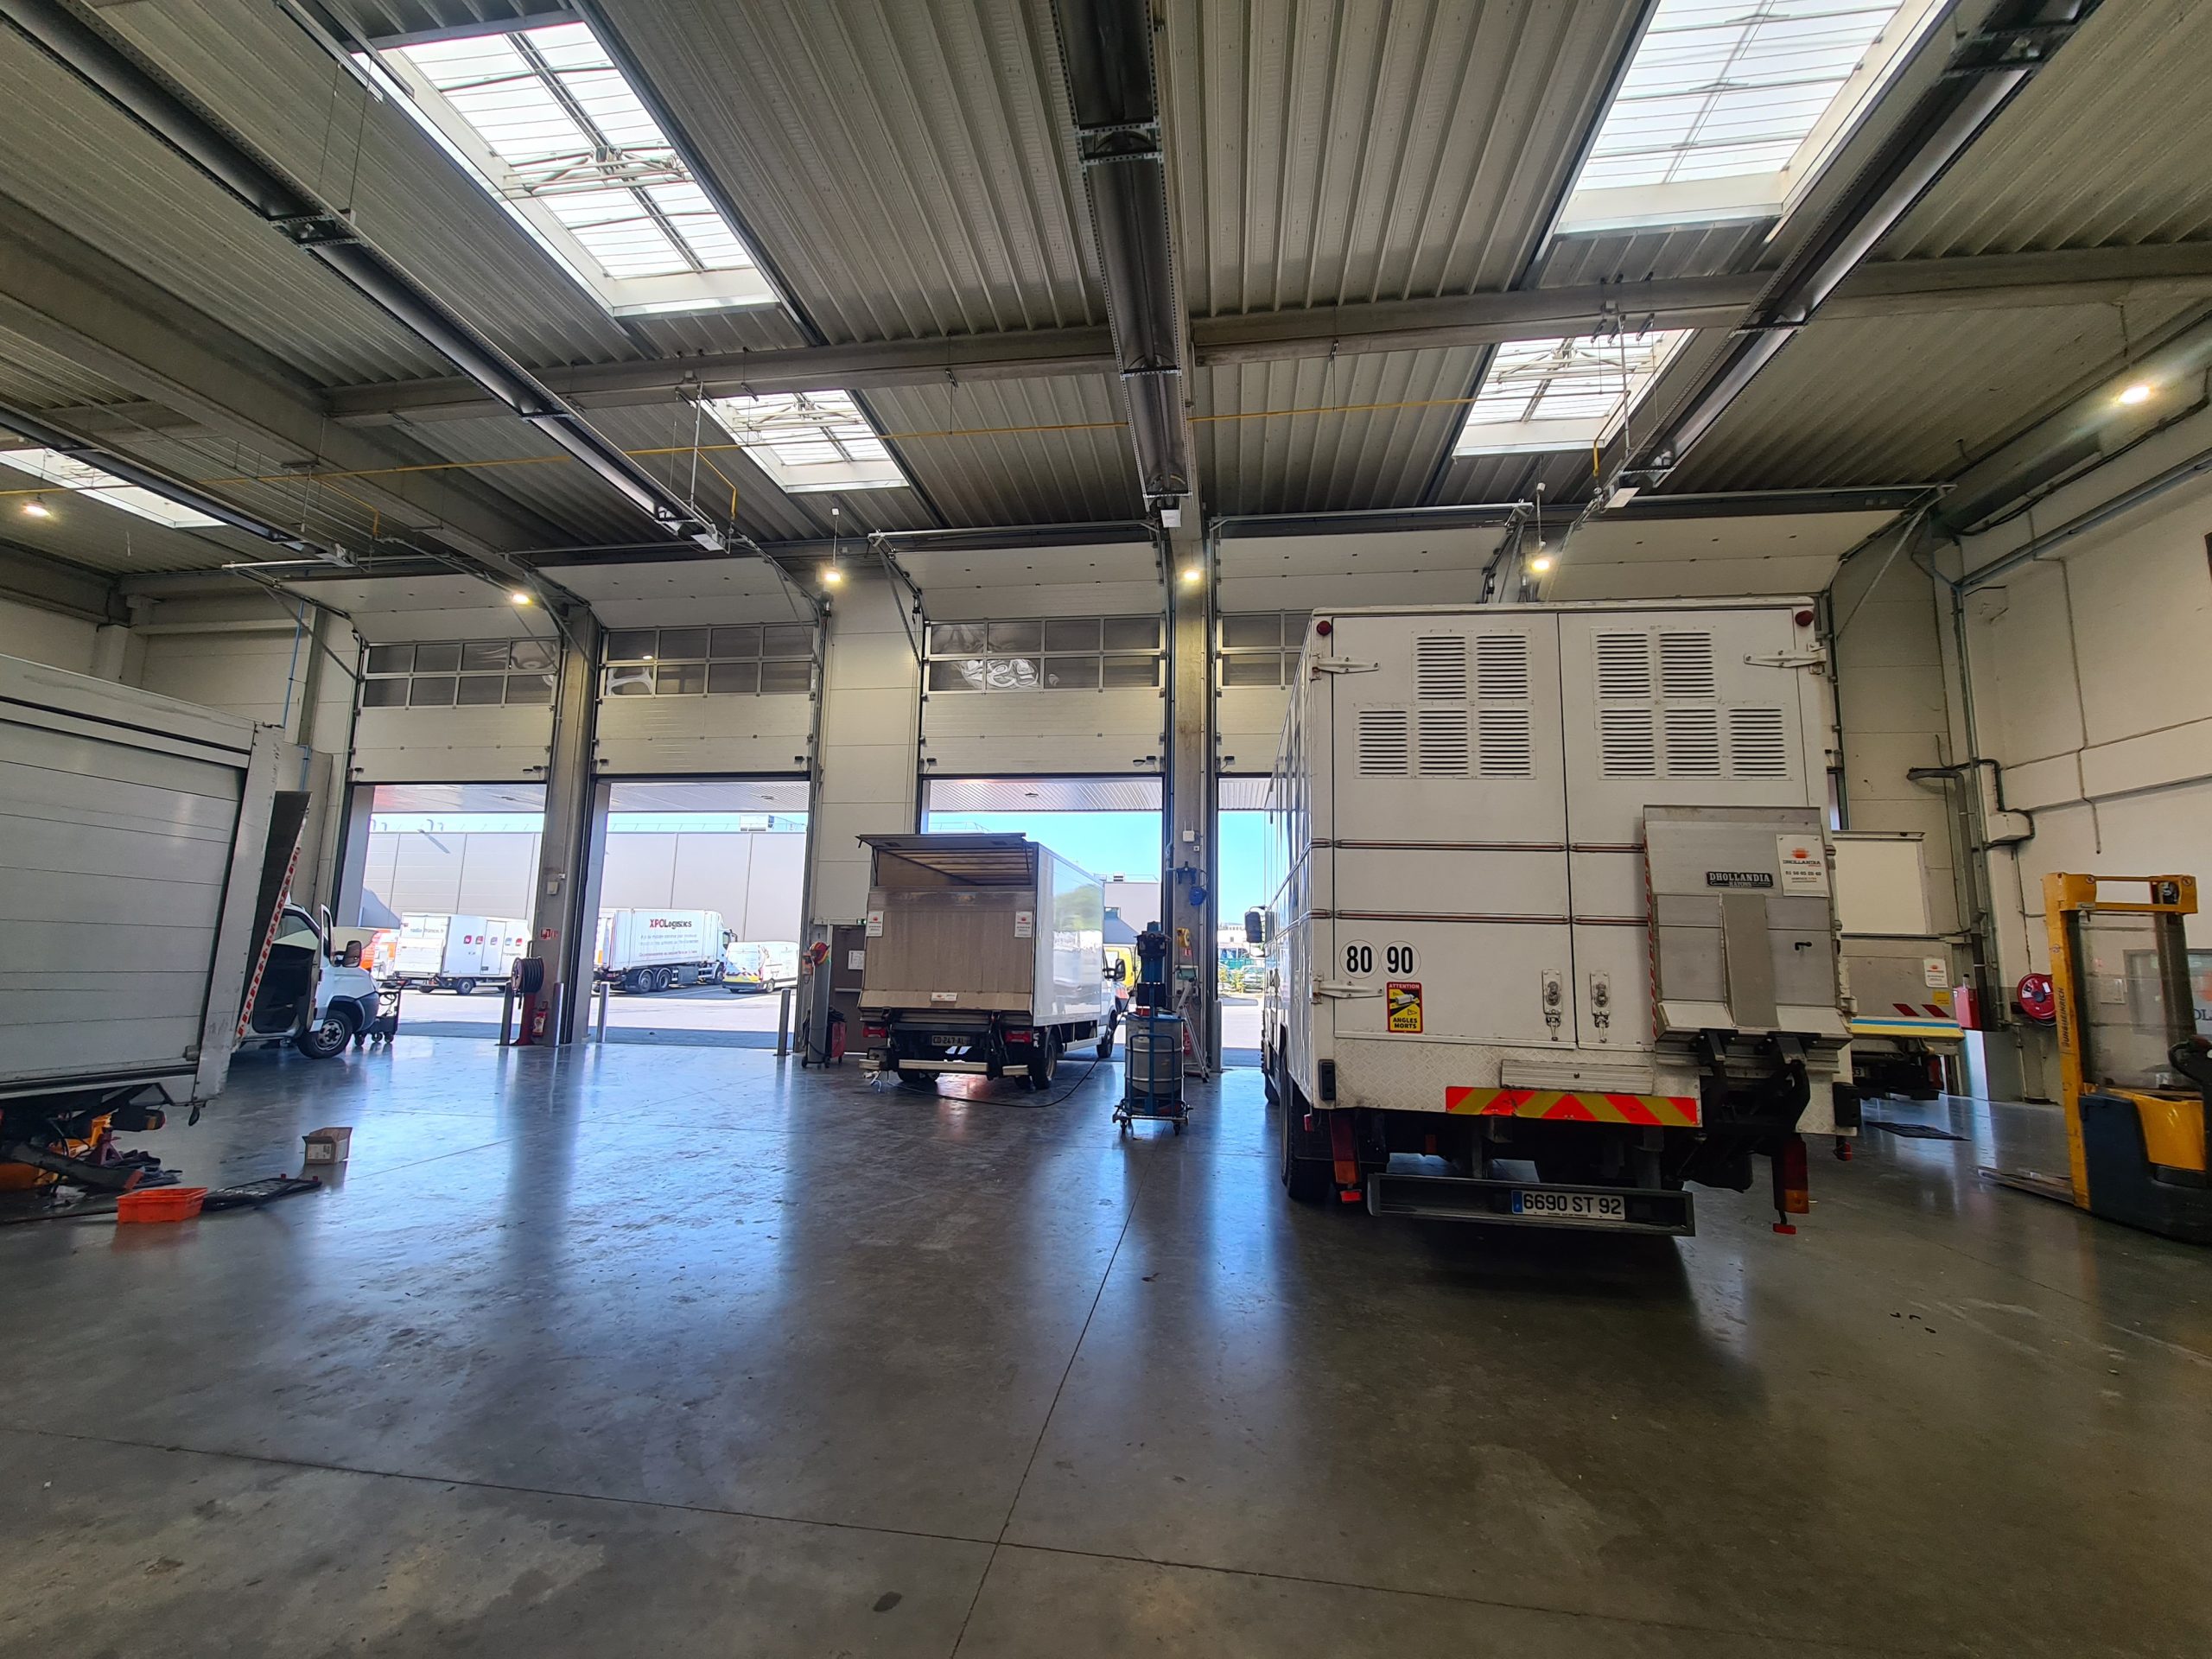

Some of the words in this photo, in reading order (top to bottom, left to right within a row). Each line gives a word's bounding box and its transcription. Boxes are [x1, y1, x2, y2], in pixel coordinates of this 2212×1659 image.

[1710, 873, 1770, 881] DHOLLANDIA
[1346, 945, 1372, 973] 80
[1387, 946, 1414, 974] 90
[1523, 1193, 1567, 1211] 6690
[1572, 1196, 1594, 1213] ST
[1599, 1198, 1622, 1215] 92
